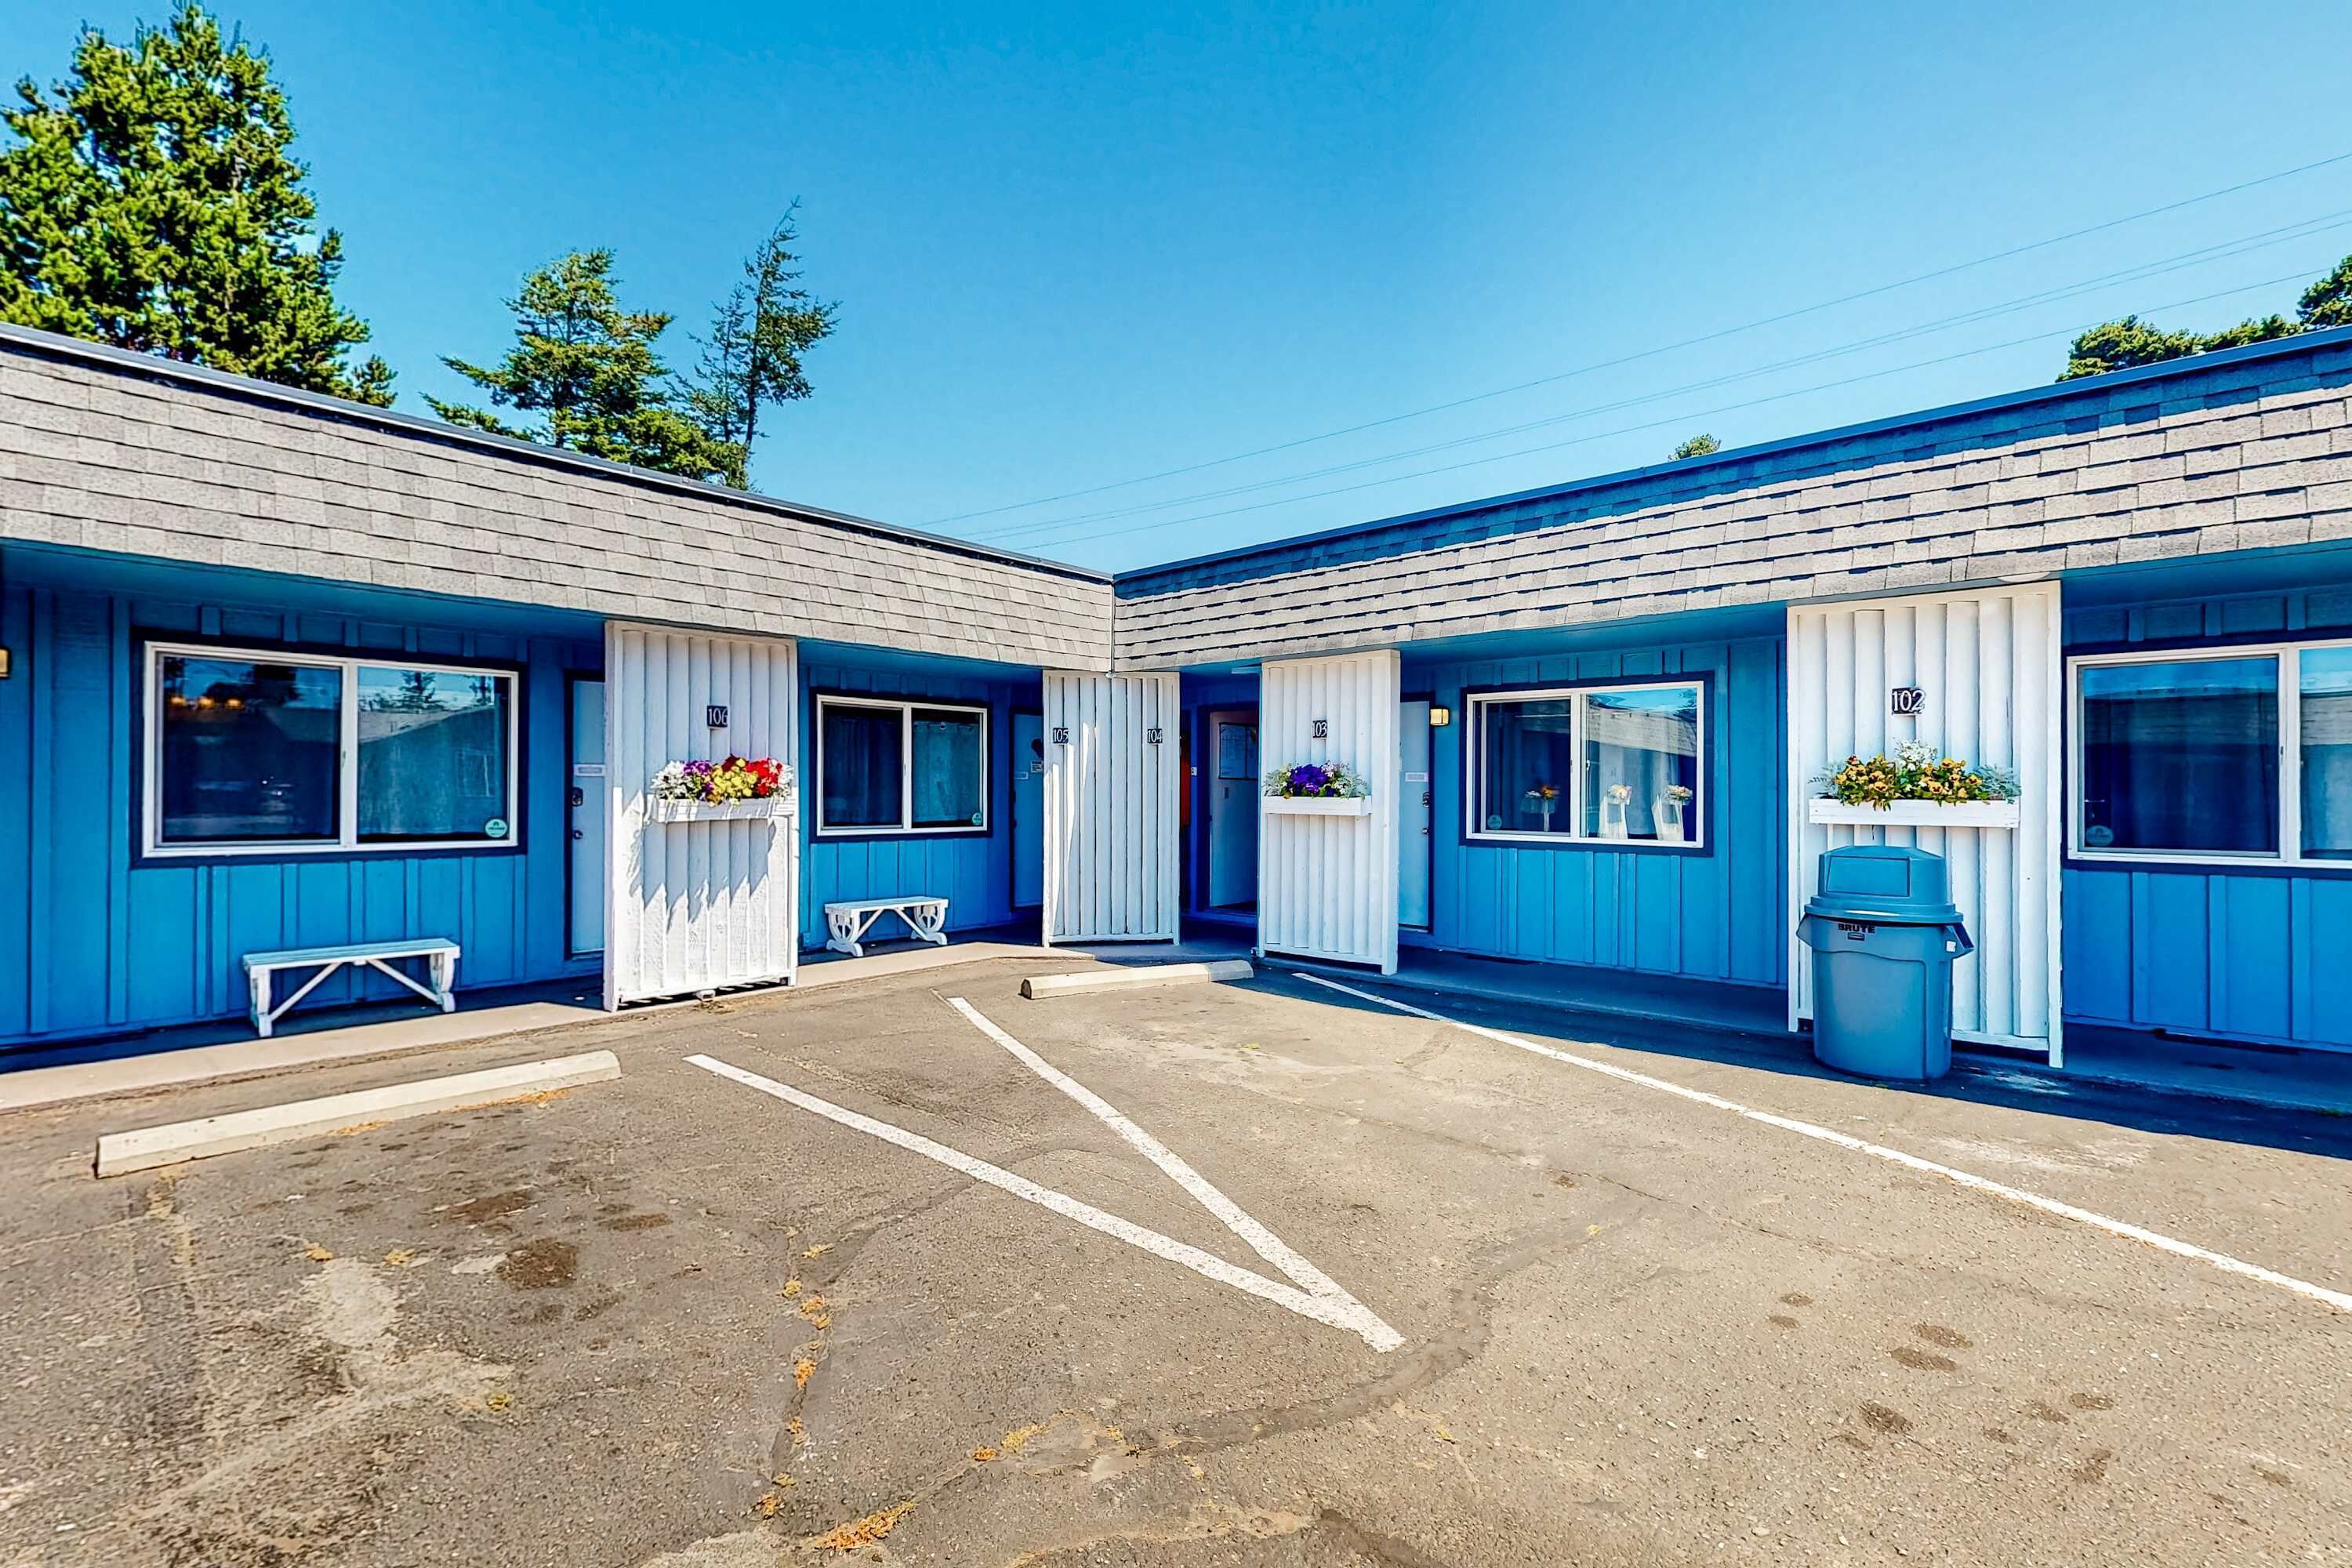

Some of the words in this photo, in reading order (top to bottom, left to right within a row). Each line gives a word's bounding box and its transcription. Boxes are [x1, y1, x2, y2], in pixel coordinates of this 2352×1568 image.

[1892, 690, 1926, 711] 102
[708, 708, 728, 726] 106
[1053, 729, 1069, 742] 105
[1147, 729, 1163, 742] 104
[1312, 722, 1327, 737] 103
[1838, 923, 1875, 934] BRUTE
